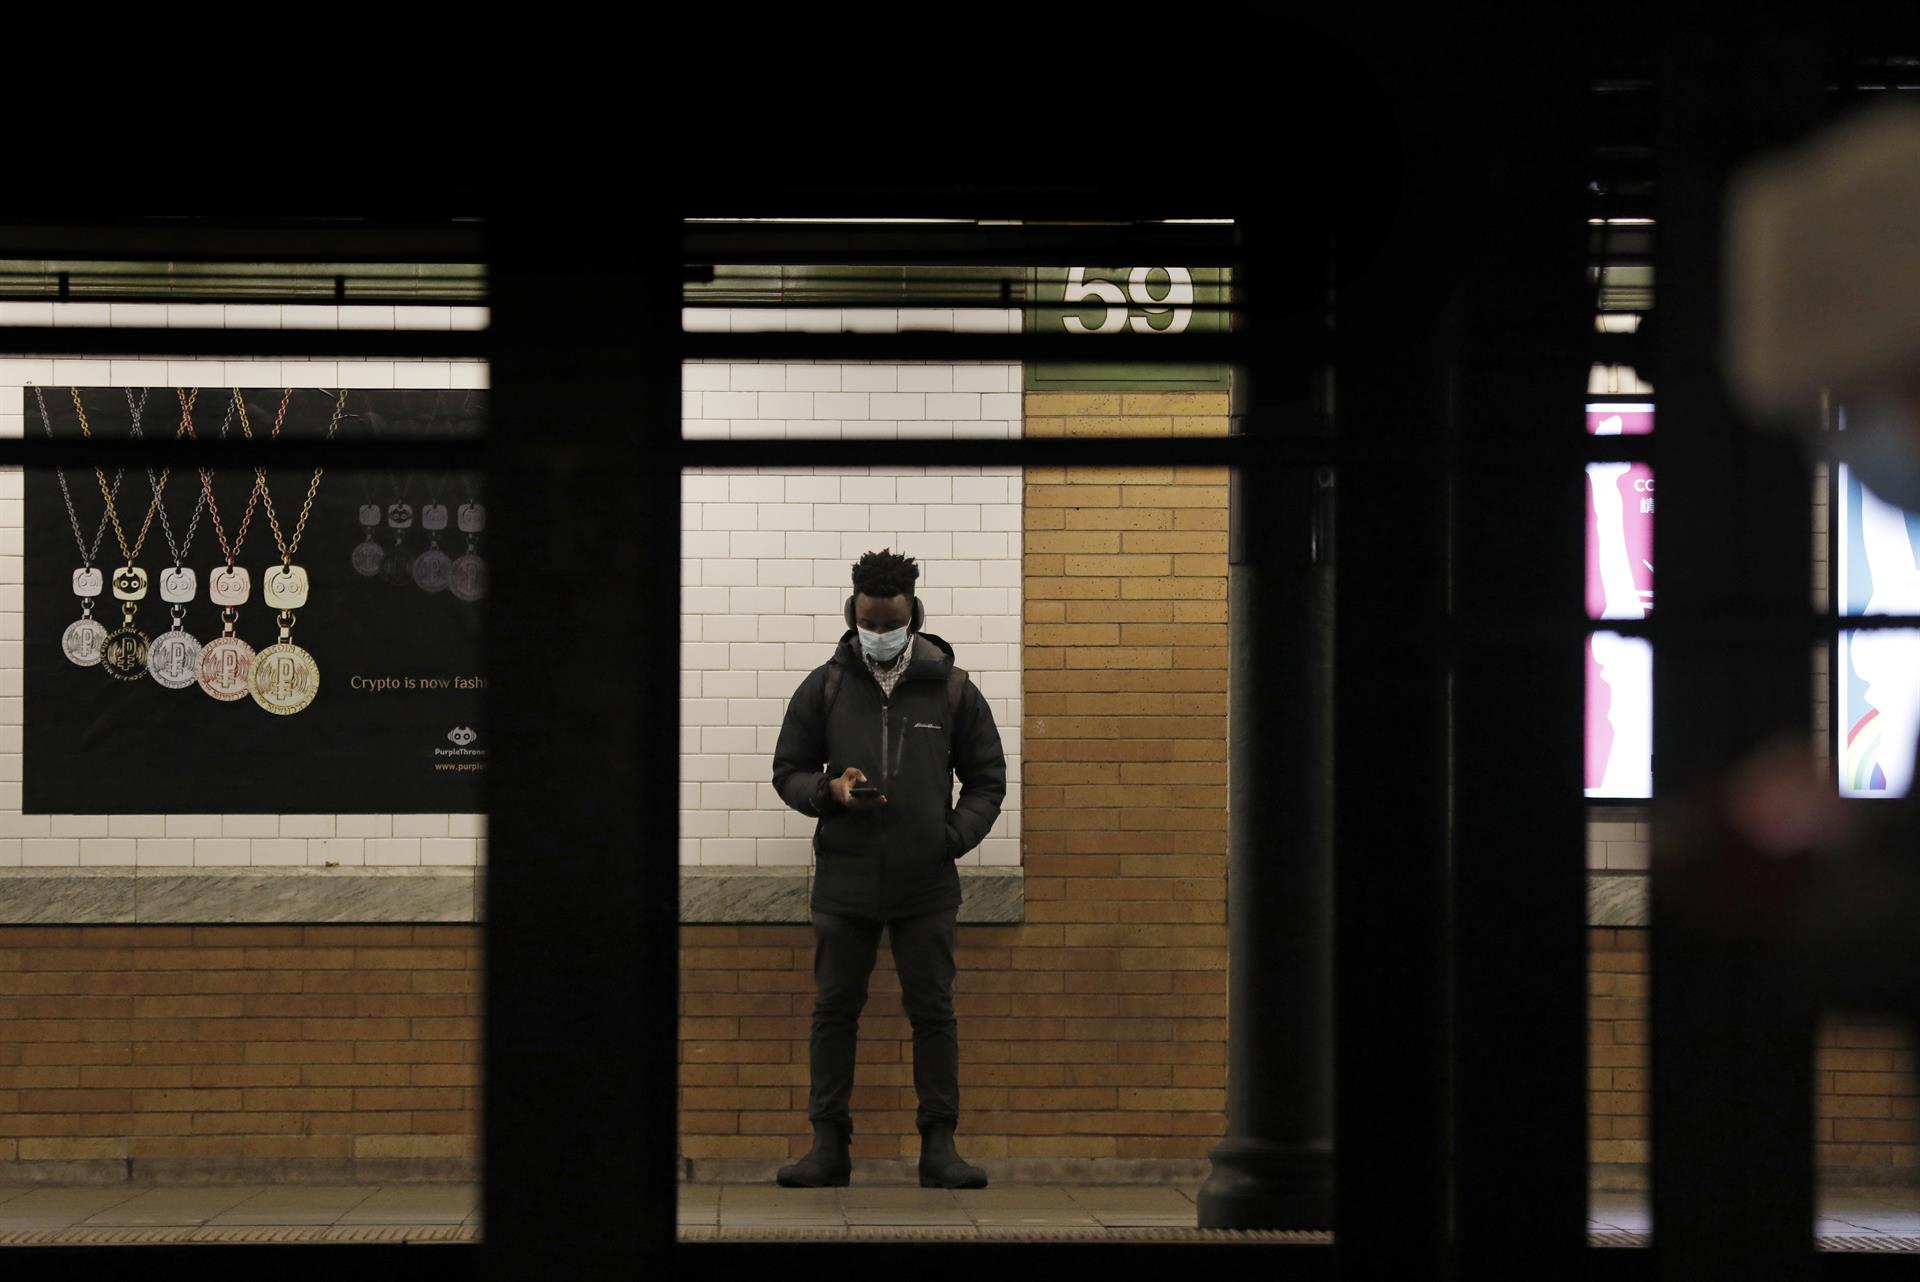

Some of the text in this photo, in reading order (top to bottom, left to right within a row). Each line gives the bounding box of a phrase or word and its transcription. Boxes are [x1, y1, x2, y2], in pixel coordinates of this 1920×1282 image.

[1062, 267, 1194, 334] 59
[350, 675, 400, 691] Crypto
[405, 676, 416, 689] is
[420, 678, 450, 689] now
